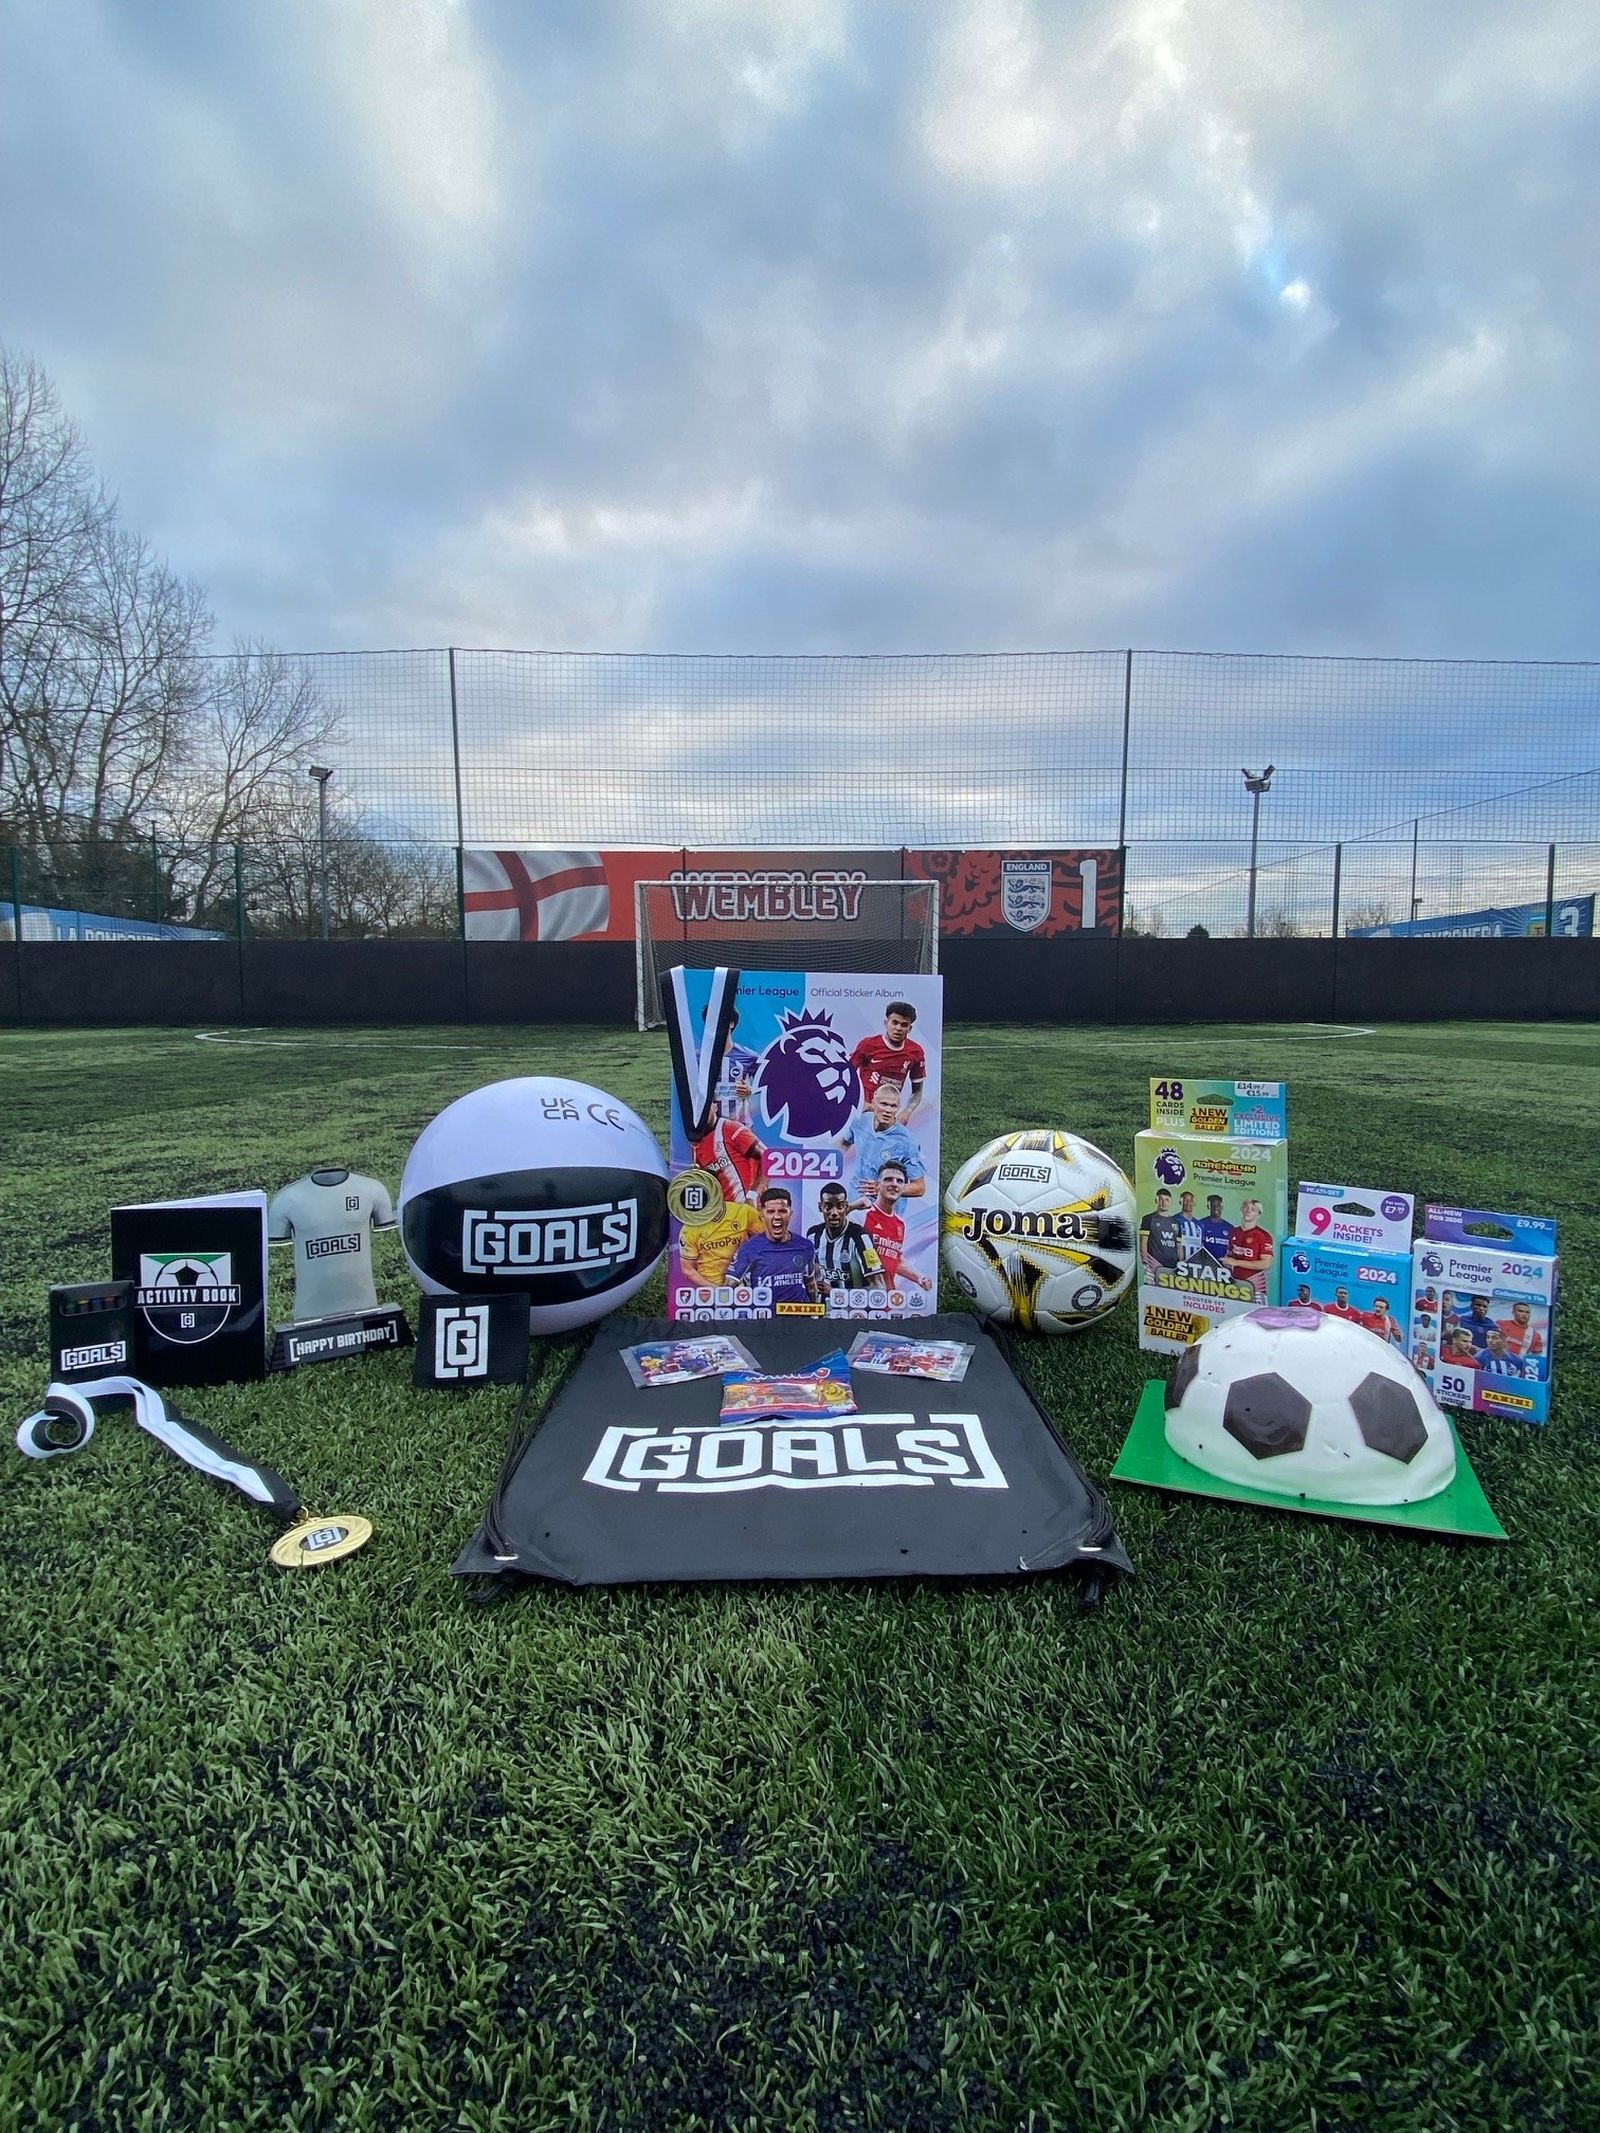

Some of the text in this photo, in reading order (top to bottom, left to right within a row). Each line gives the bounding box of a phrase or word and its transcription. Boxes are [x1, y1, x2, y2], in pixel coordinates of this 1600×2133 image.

[1006, 863, 1048, 872] ENGLAND
[670, 870, 867, 921] WEMBLEY
[1080, 859, 1097, 928] 1
[759, 985, 800, 999] League
[810, 987, 904, 998] Official Sticker Album
[1155, 1081, 1184, 1101] 48
[541, 1098, 575, 1109] UK
[1156, 1101, 1185, 1109] CARDS
[543, 1109, 580, 1121] CA
[587, 1103, 624, 1131] CE
[1156, 1108, 1185, 1116] INSIDE
[1156, 1117, 1186, 1127] PLUS
[1190, 1116, 1226, 1125] GOLDEN
[1234, 1119, 1280, 1130] LIMITED
[1194, 1124, 1225, 1132] BALLER
[1234, 1128, 1280, 1137] EDITIONS
[1230, 1146, 1272, 1161] 2024
[767, 1151, 838, 1177] 2024
[1193, 1172, 1256, 1187] Premier League
[1428, 1207, 1463, 1218] ALL-NEW
[1308, 1206, 1332, 1236] 9
[1516, 1219, 1546, 1230] £9.99
[1333, 1223, 1384, 1237] PACKETS
[700, 1235, 742, 1251] AstroPay
[1332, 1231, 1373, 1244] INSIDE!
[1176, 1261, 1232, 1283] STAR
[1315, 1257, 1350, 1270] Premier
[1358, 1267, 1398, 1284] 2024
[1449, 1268, 1493, 1284] League
[1450, 1259, 1544, 1279] Premier 2024
[1158, 1273, 1252, 1301] SIGNINGS
[137, 1288, 237, 1304] ACTIVITY BOOK
[778, 1304, 823, 1313] PANINI
[1183, 1300, 1226, 1314] INCLUDES
[1145, 1317, 1189, 1333] GOLDEN
[1150, 1327, 1189, 1343] BALLER
[1441, 1375, 1466, 1393] 50
[1436, 1388, 1471, 1401] STICKERS
[1483, 1392, 1532, 1408] PANINI
